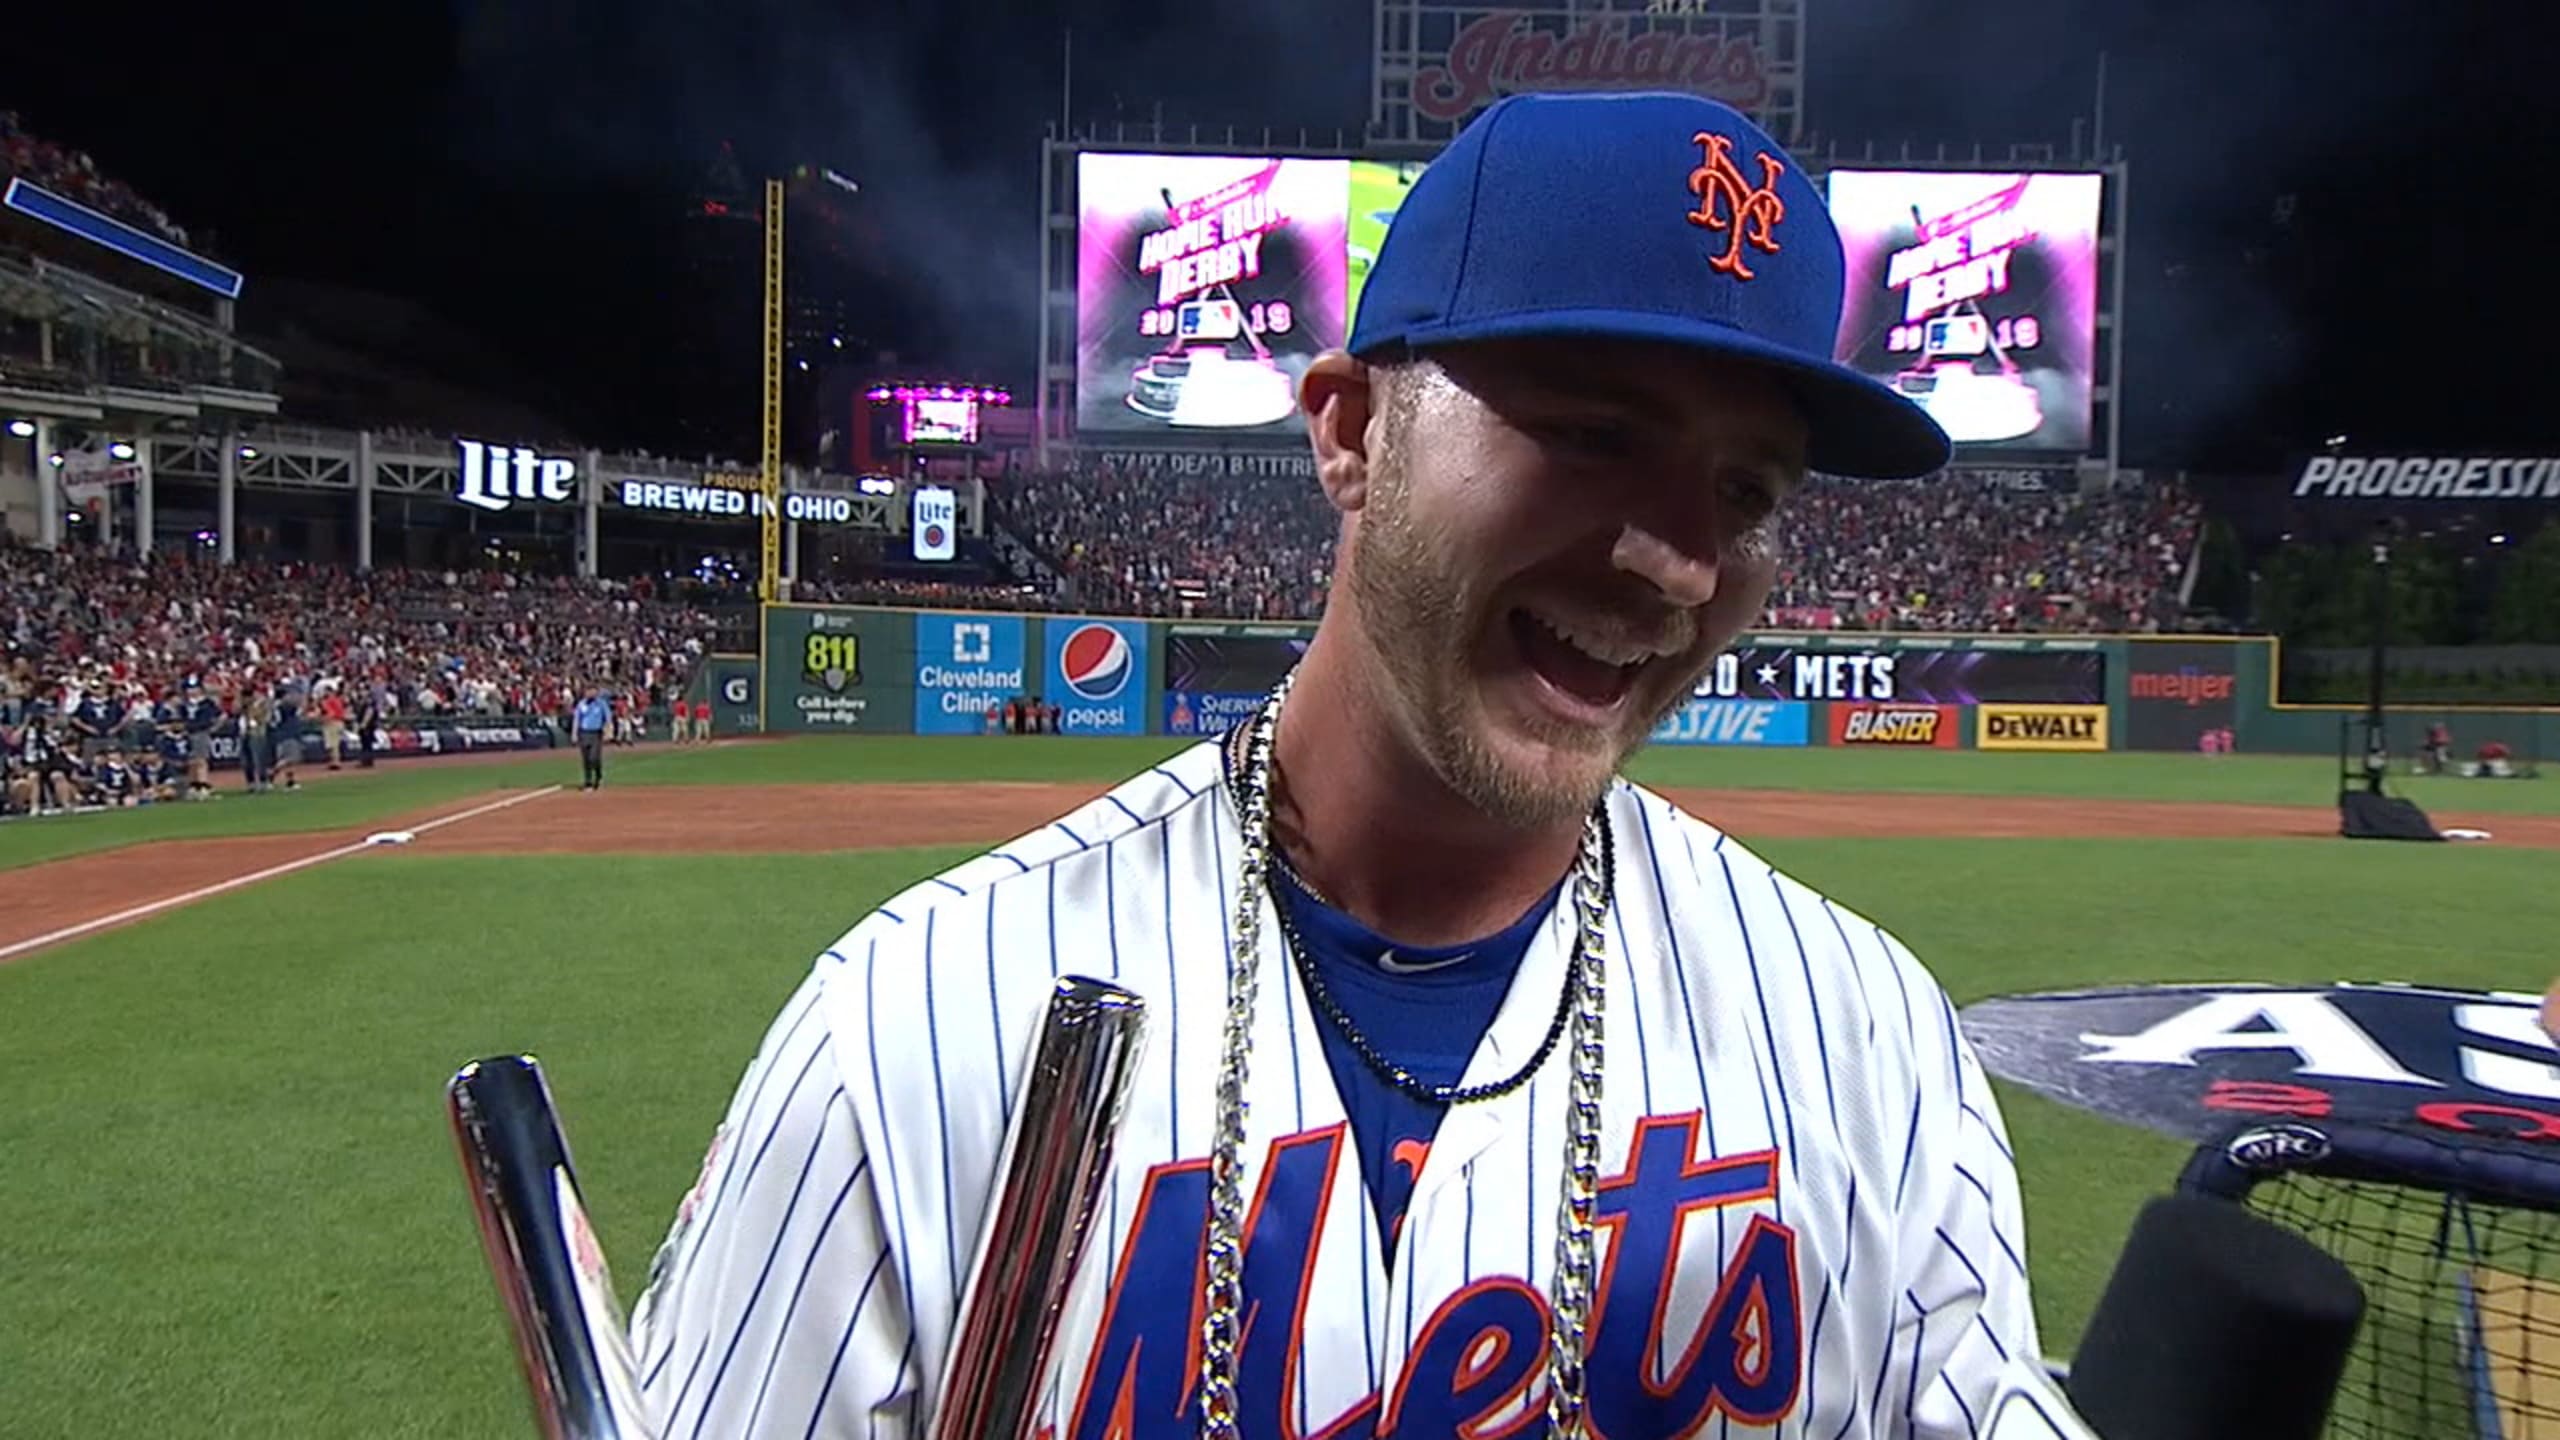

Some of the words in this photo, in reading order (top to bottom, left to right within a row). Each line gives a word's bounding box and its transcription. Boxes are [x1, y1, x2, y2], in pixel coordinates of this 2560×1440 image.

[1411, 12, 1767, 120] Indians
[1687, 131, 1785, 281] NY
[1158, 232, 1262, 304] DERBY
[458, 439, 576, 511] Lite
[624, 480, 744, 516] BREWED
[787, 494, 851, 522] OHIO
[919, 502, 952, 523] Lite
[807, 634, 856, 673] 811
[724, 678, 748, 702] G
[920, 666, 1022, 689] Cleveland
[1795, 655, 1895, 699] METS
[2130, 666, 2234, 706] meijer
[825, 697, 865, 710] before
[942, 690, 999, 713] Clinic
[1067, 705, 1125, 726] pepsi
[1844, 711, 1939, 741] BLASTER
[1066, 1108, 1803, 1440] Mets
